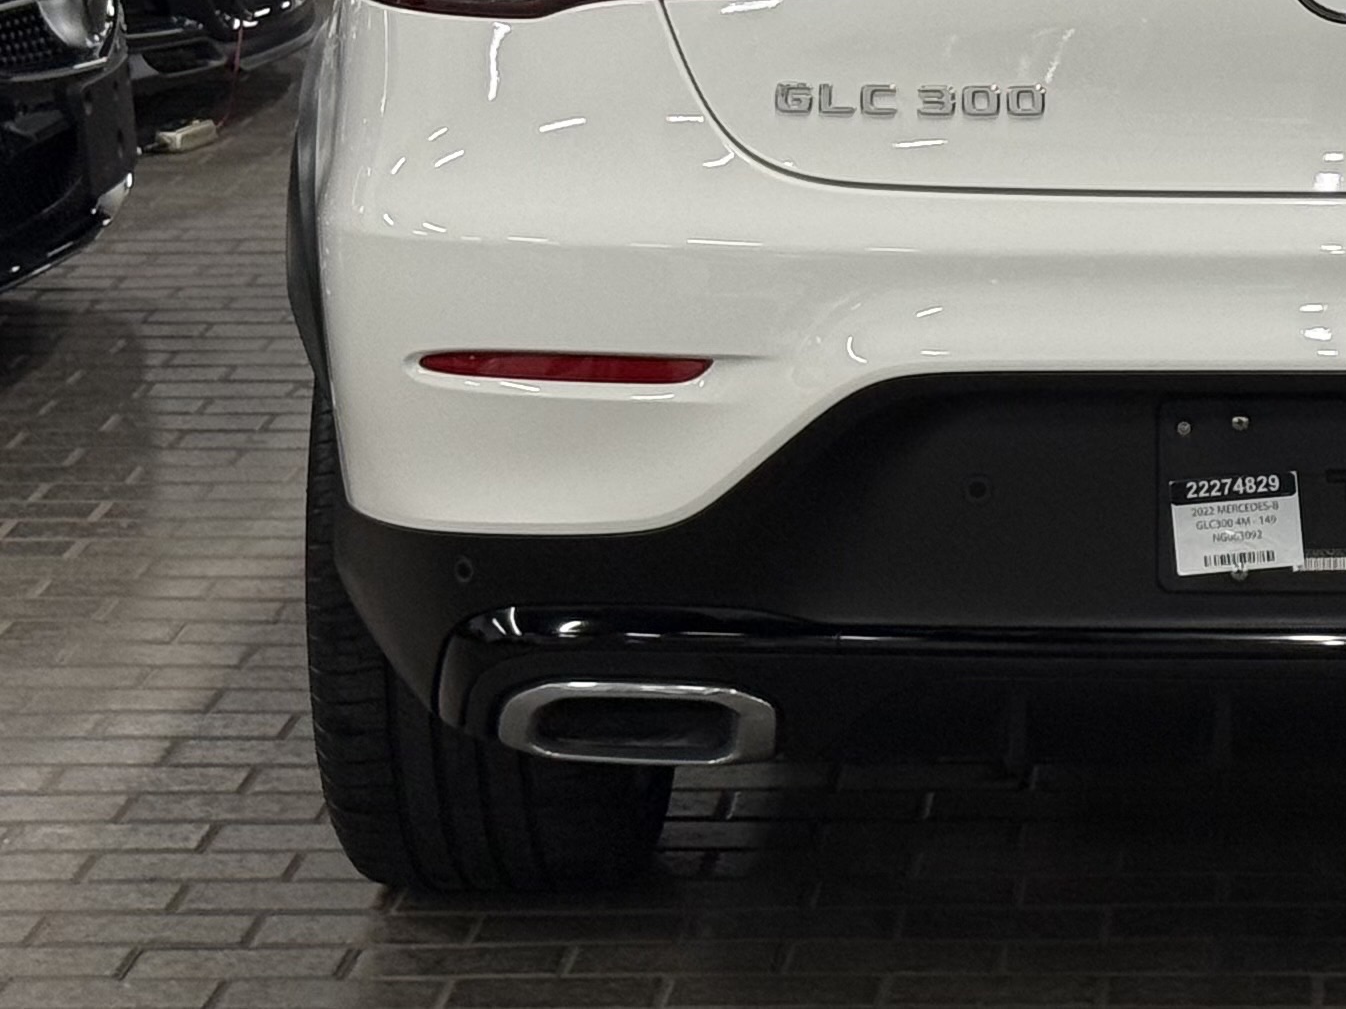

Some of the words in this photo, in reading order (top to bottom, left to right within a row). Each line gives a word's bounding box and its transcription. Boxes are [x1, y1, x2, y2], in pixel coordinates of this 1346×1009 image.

[774, 82, 898, 117] GLC
[916, 84, 1046, 118] 300
[1186, 474, 1281, 499] 22274829
[1191, 505, 1215, 518] 2022
[1195, 518, 1234, 531] GLC300
[1235, 516, 1251, 527] 4M
